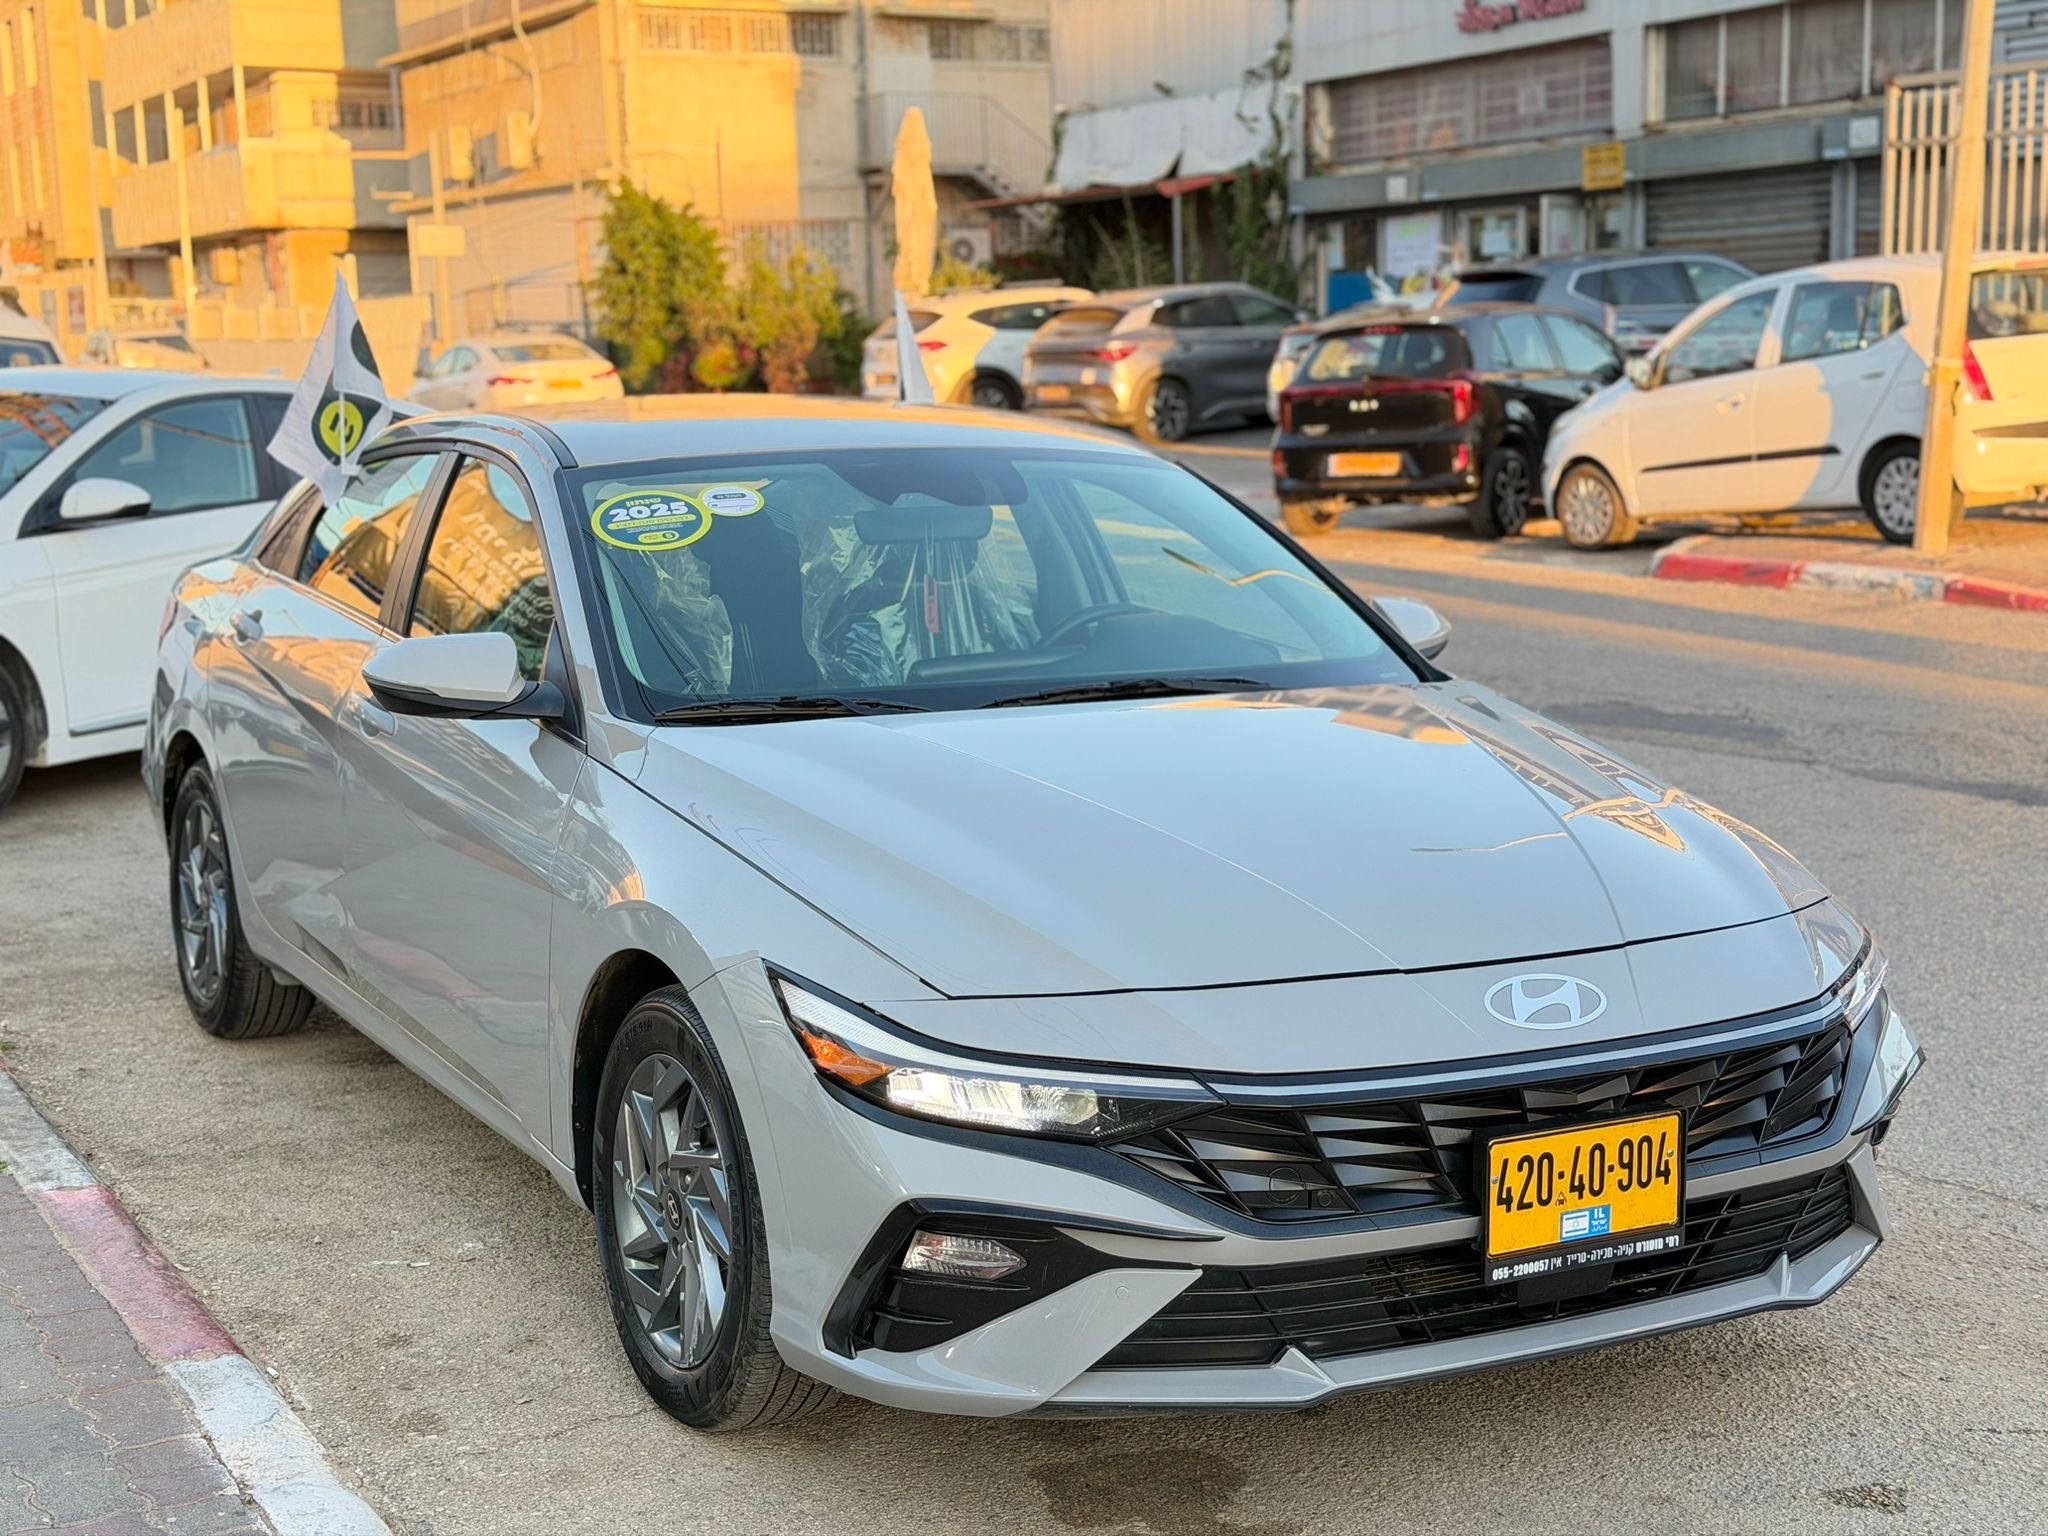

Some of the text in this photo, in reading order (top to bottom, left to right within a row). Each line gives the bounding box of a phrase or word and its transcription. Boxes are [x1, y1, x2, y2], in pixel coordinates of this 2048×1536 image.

[608, 501, 689, 522] 2025
[1593, 1207, 1605, 1219] IL
[1665, 1234, 1680, 1248] רמי
[1492, 1258, 1549, 1281] 055-2200057
[1550, 1256, 1562, 1270] אין
